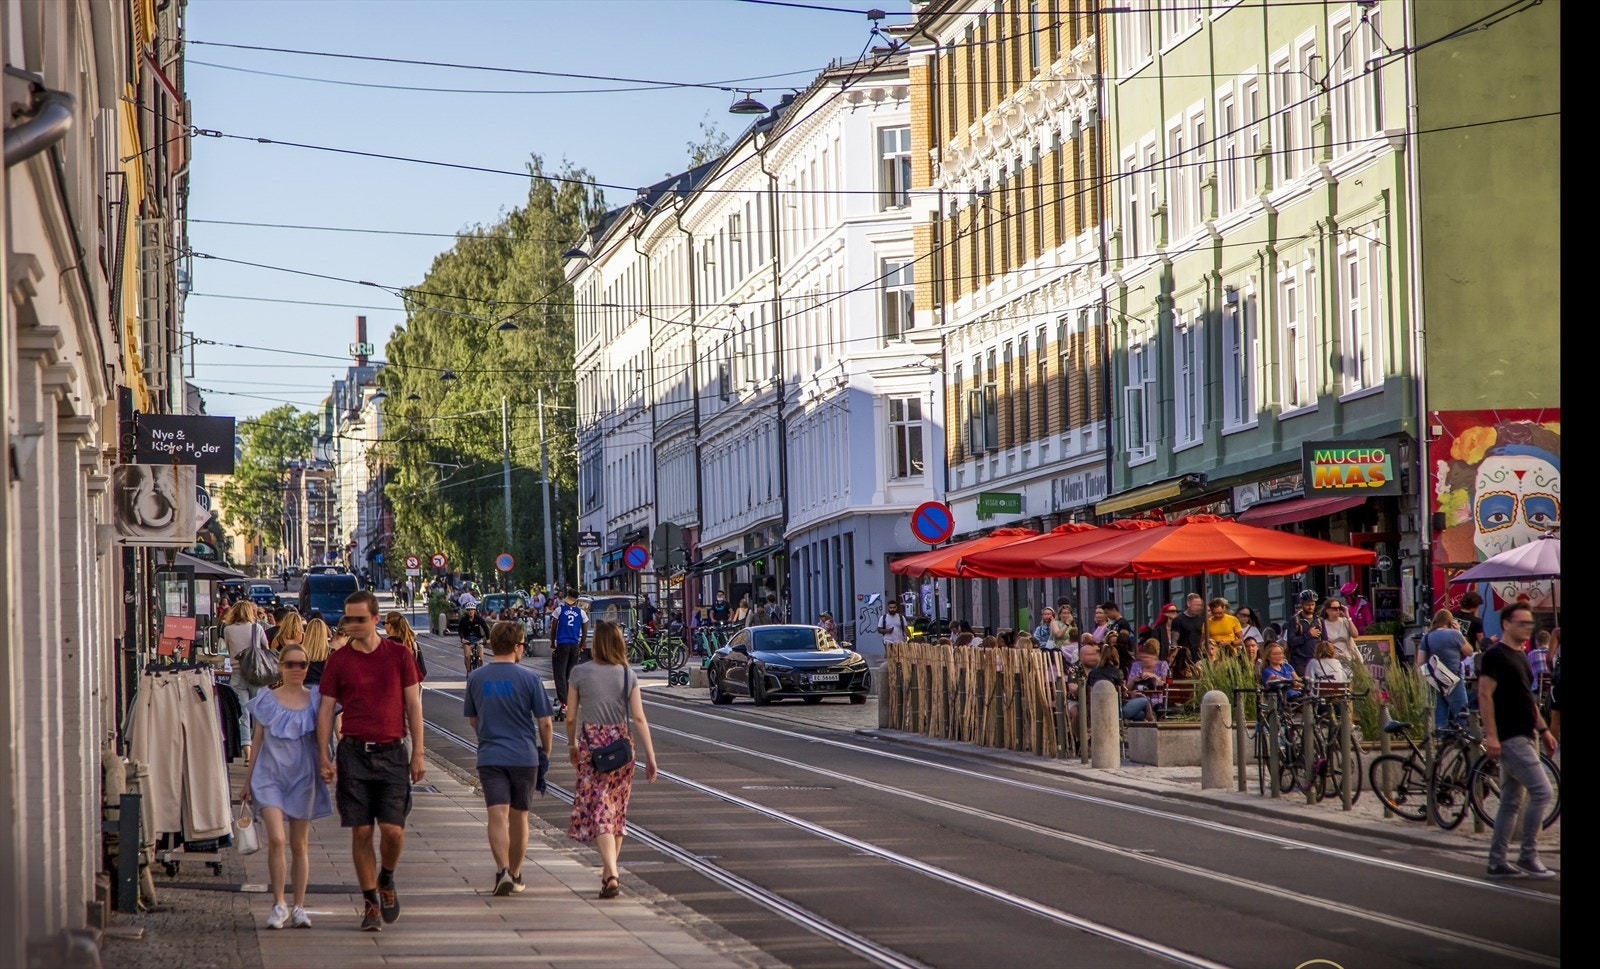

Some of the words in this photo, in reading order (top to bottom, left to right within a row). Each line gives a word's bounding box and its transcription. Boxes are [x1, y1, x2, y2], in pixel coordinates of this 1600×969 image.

[152, 430, 174, 441] Nye
[176, 430, 185, 440] &
[1315, 449, 1385, 464] MUCHO
[1313, 465, 1386, 489] MAS
[1061, 476, 1084, 504] Velouria
[1085, 473, 1106, 501] Vintage
[568, 615, 574, 626] 2
[1357, 644, 1372, 655] Try
